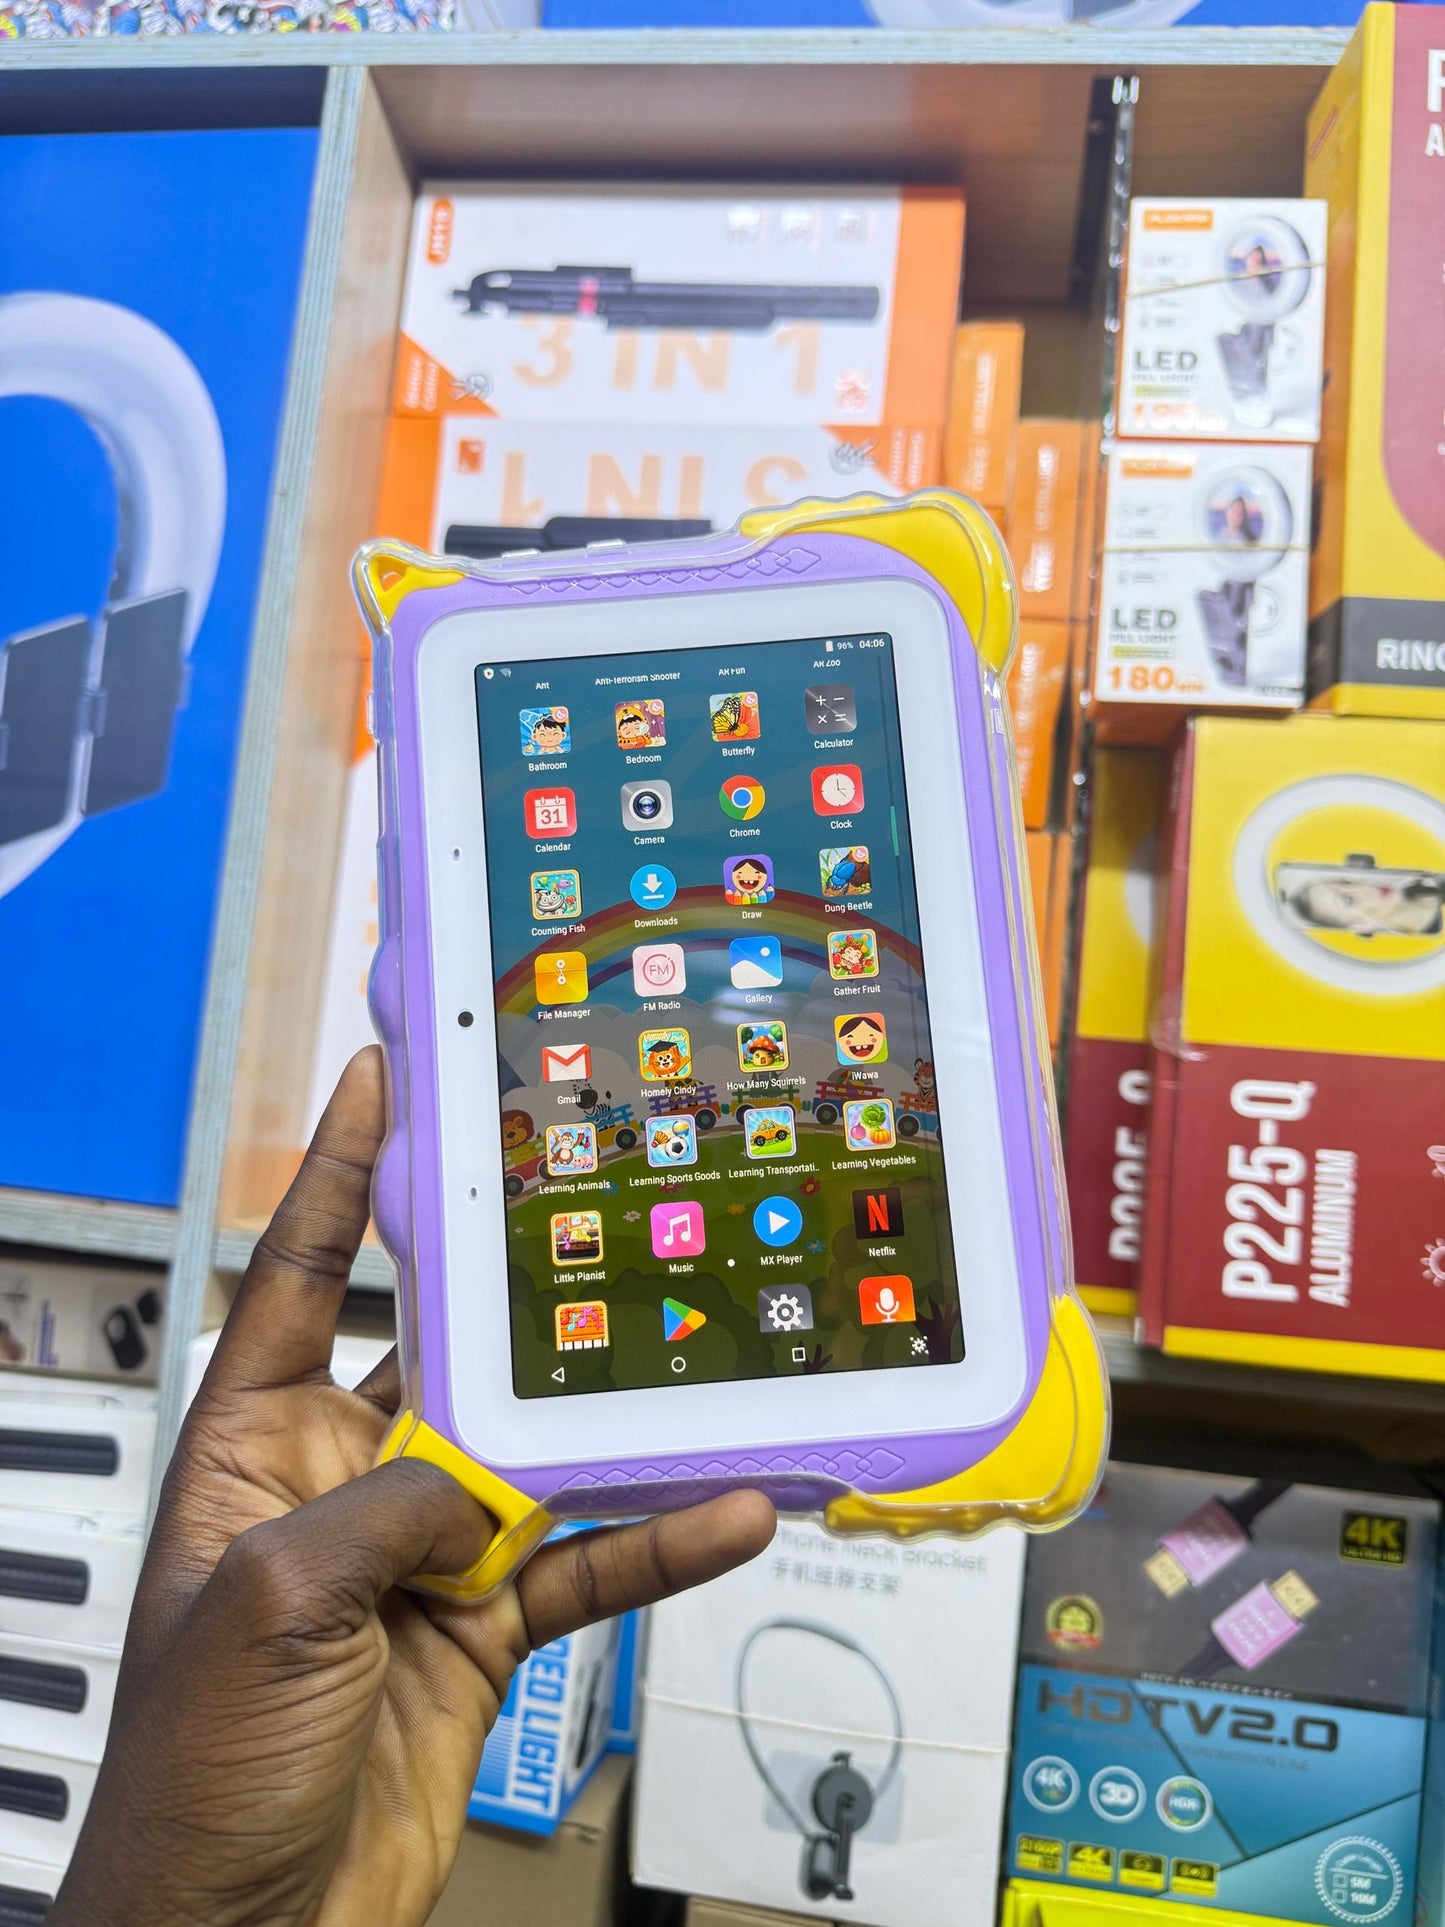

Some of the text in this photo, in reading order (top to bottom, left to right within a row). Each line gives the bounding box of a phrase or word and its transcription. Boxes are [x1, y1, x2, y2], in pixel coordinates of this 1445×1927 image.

[513, 315, 575, 389] 3
[612, 329, 731, 392] IN
[777, 320, 823, 394] 1
[1134, 350, 1199, 371] LED
[1113, 608, 1178, 630] LED
[837, 639, 885, 650] 96% 04:06
[1107, 666, 1175, 692] 180
[535, 682, 550, 690] Ant
[814, 738, 855, 749] Calculator
[722, 745, 756, 757] Butterfly
[626, 754, 662, 764] Bedroom
[528, 761, 568, 772] Bathroom
[540, 808, 563, 825] 31
[830, 820, 853, 830] Clock
[729, 828, 761, 838] Chrome
[535, 842, 571, 853] Calendar
[634, 836, 665, 846] Camera
[825, 901, 873, 914] Dung Beetle
[742, 911, 763, 920] Draw
[634, 917, 679, 928] Downloads
[531, 924, 586, 937] Counting Fish
[649, 964, 669, 977] FM
[833, 984, 881, 996] Gather Fruit
[745, 993, 773, 1004] Gallery
[643, 1001, 681, 1012] FM Radio
[538, 1008, 591, 1020] File Manager
[851, 1071, 879, 1081] iWawa
[726, 1076, 807, 1091] How Many Squirrels
[640, 1085, 697, 1098] Homely Cindy
[557, 1094, 582, 1105] Gmail
[832, 1155, 917, 1170] Learning Vegetables
[728, 1162, 820, 1178] Learning Transportati..
[629, 1170, 721, 1186] Learning Sports Goods
[539, 1180, 611, 1195] Learning Animals
[1221, 1079, 1318, 1303] P225-Q
[1308, 1149, 1359, 1308] ALUMINUM
[868, 1246, 897, 1257] Netflix
[760, 1254, 803, 1266] MX Player
[668, 1263, 694, 1274] Music
[554, 1270, 606, 1284] Little Pianist
[1344, 1515, 1400, 1550] 4K
[1037, 1678, 1340, 1753] HDTV2.0
[512, 1707, 563, 1810] LIGHT
[1034, 1765, 1067, 1789] 4K
[1099, 1780, 1137, 1807] 3D
